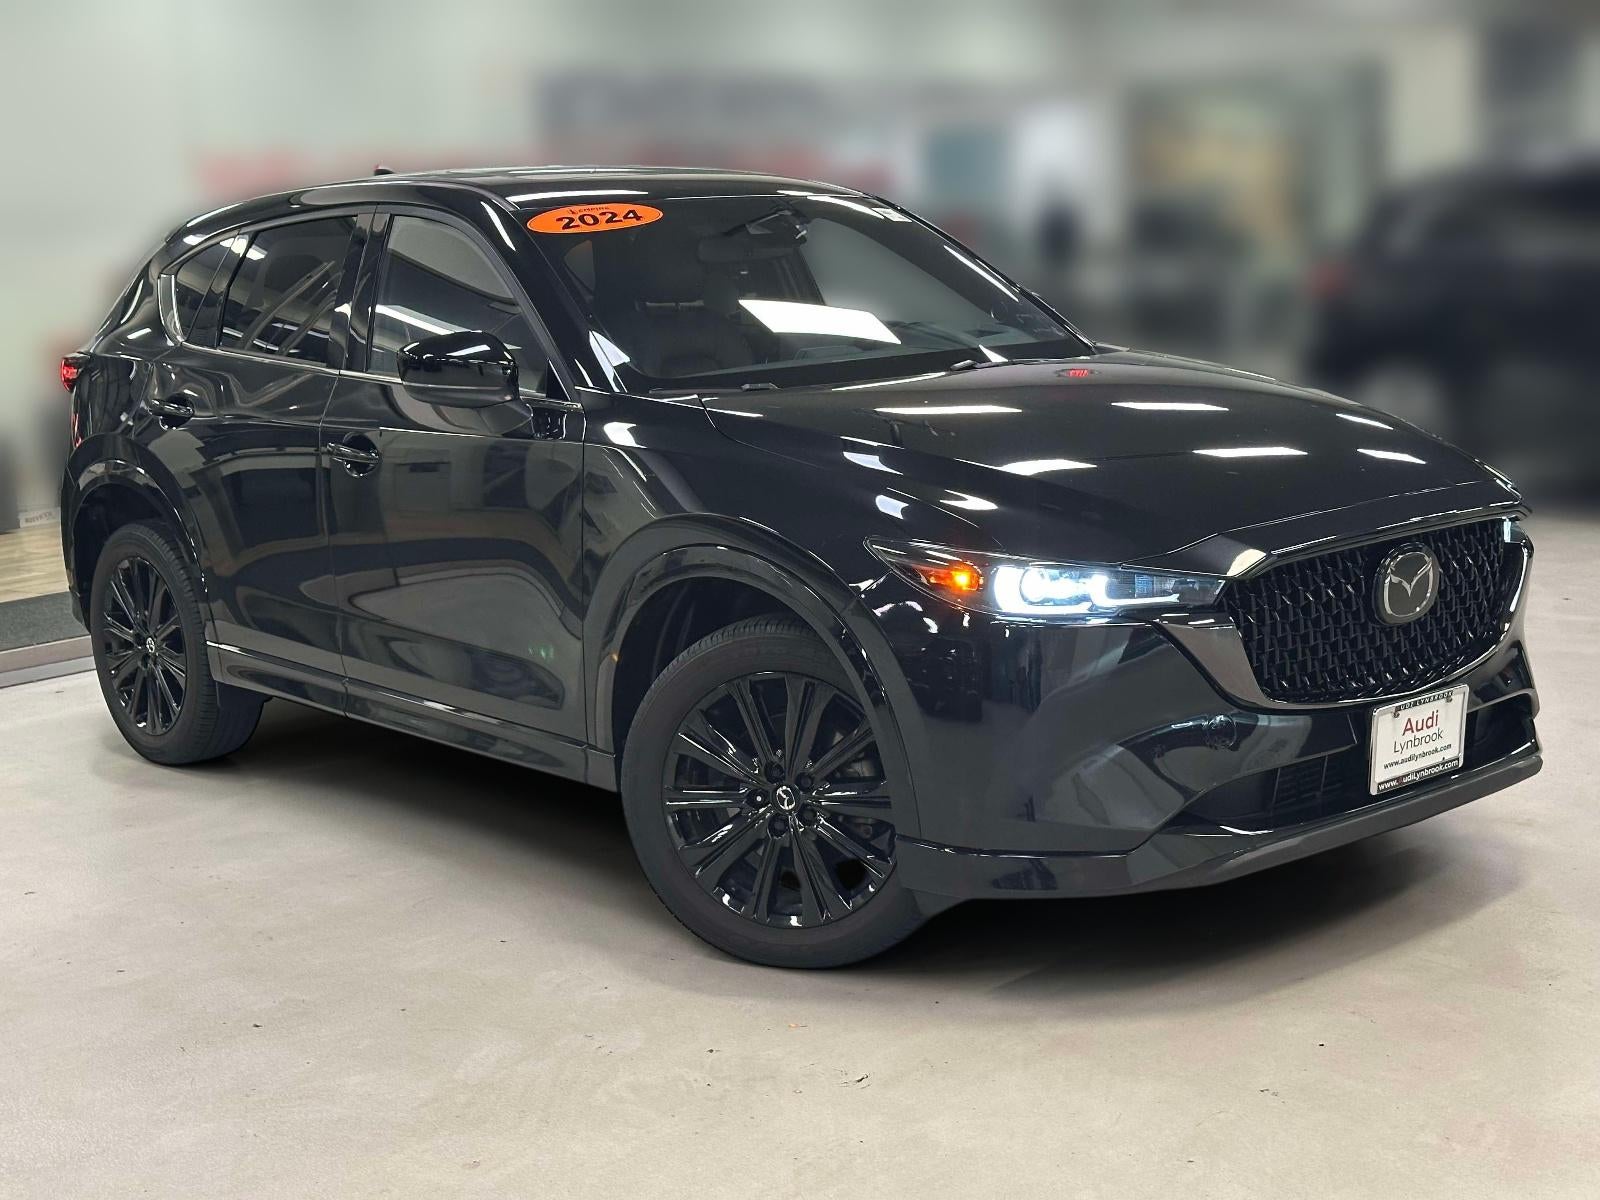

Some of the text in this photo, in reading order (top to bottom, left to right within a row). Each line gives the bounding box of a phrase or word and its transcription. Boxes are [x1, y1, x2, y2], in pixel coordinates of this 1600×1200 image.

[556, 209, 643, 230] 2024
[1416, 690, 1453, 706] LYNBROOK
[1402, 709, 1439, 736] Audi
[1393, 727, 1443, 754] Lynbrook
[1383, 743, 1452, 769] www.audilynbrook.com
